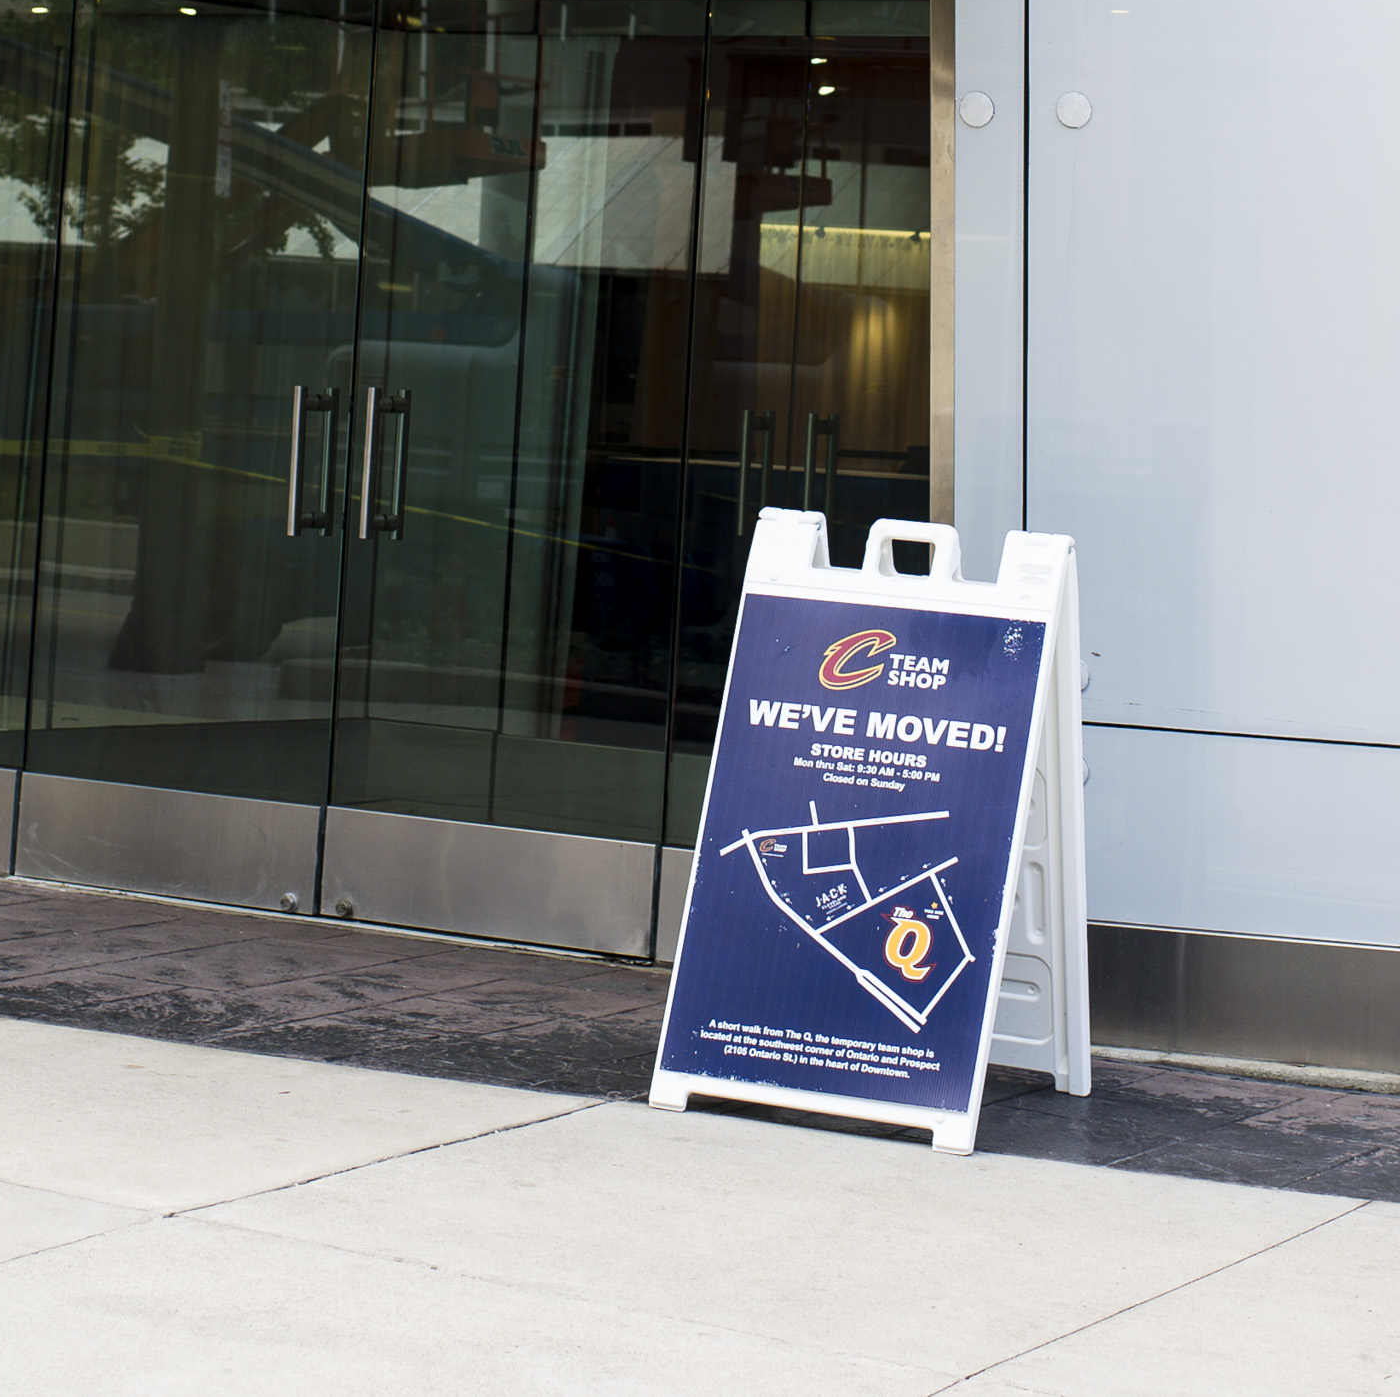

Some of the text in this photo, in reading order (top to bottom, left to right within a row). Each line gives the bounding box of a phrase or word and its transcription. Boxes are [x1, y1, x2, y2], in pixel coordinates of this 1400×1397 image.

[889, 653, 950, 674] TEAM
[887, 670, 946, 690] SHOP
[866, 711, 1007, 753] MOVED!
[810, 743, 927, 768] STORE HOURS
[793, 756, 814, 768] Mon
[815, 759, 835, 770] thru
[836, 761, 855, 773] Sat:
[857, 764, 877, 775] 9:30
[878, 766, 895, 777] AM
[902, 769, 923, 780] 5:00
[924, 771, 941, 782] PM
[823, 772, 905, 792] Closed on Sunday
[892, 906, 914, 919] The
[883, 914, 937, 982] Q
[700, 1029, 941, 1071] located at the southwest corner of Ontario and Prospect
[708, 1019, 935, 1058] A short walk from The Q, the temporary team shop is
[723, 1044, 911, 1079] (2105 Ontario St.) in the heart of Downtown.
